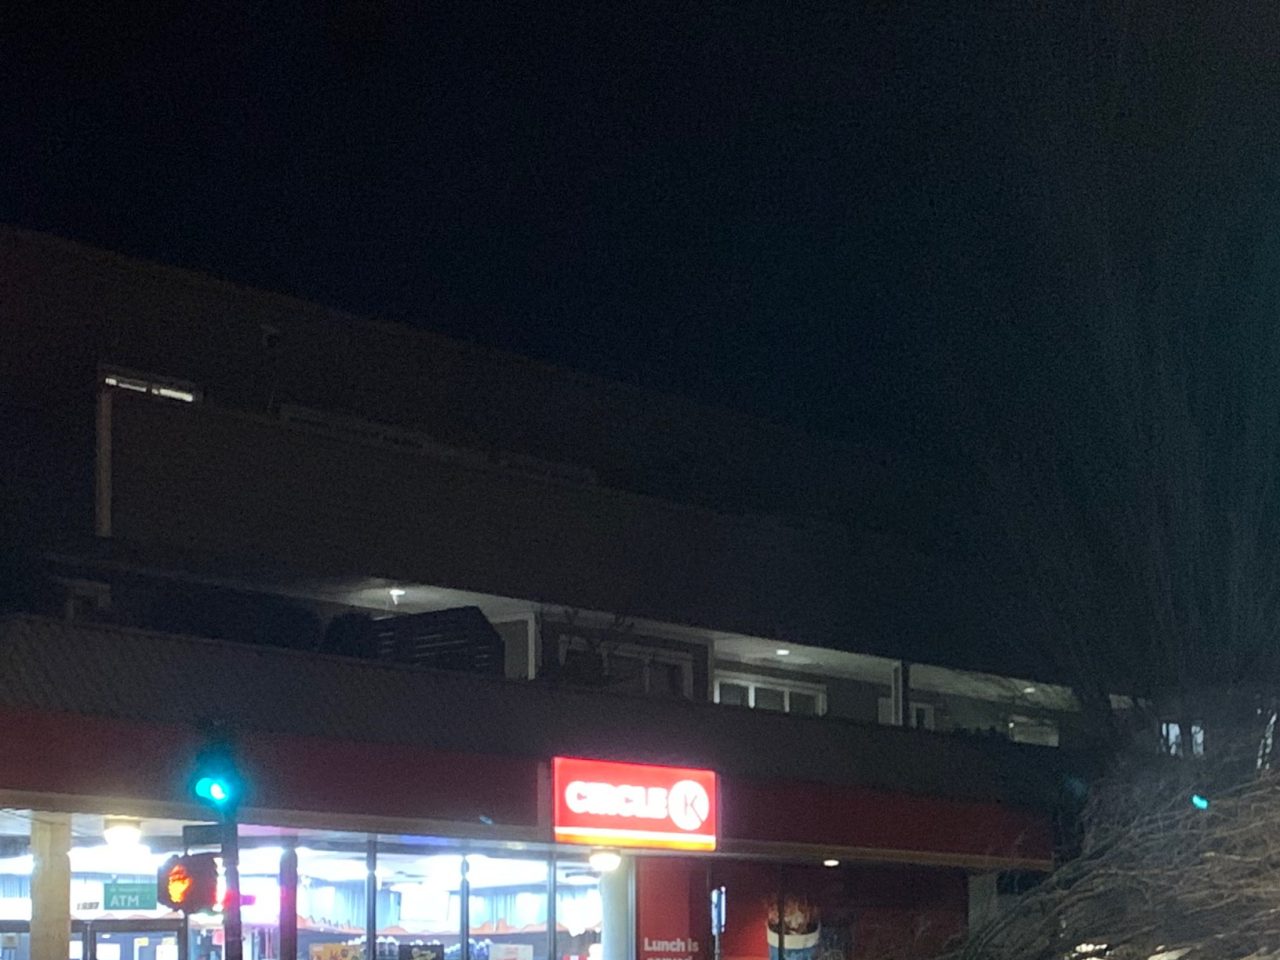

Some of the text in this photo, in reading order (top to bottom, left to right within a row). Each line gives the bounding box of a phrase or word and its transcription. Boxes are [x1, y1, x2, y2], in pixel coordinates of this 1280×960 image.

[565, 780, 668, 819] CIRCLE
[110, 895, 139, 907] ATM
[644, 937, 699, 952] Lunch is
